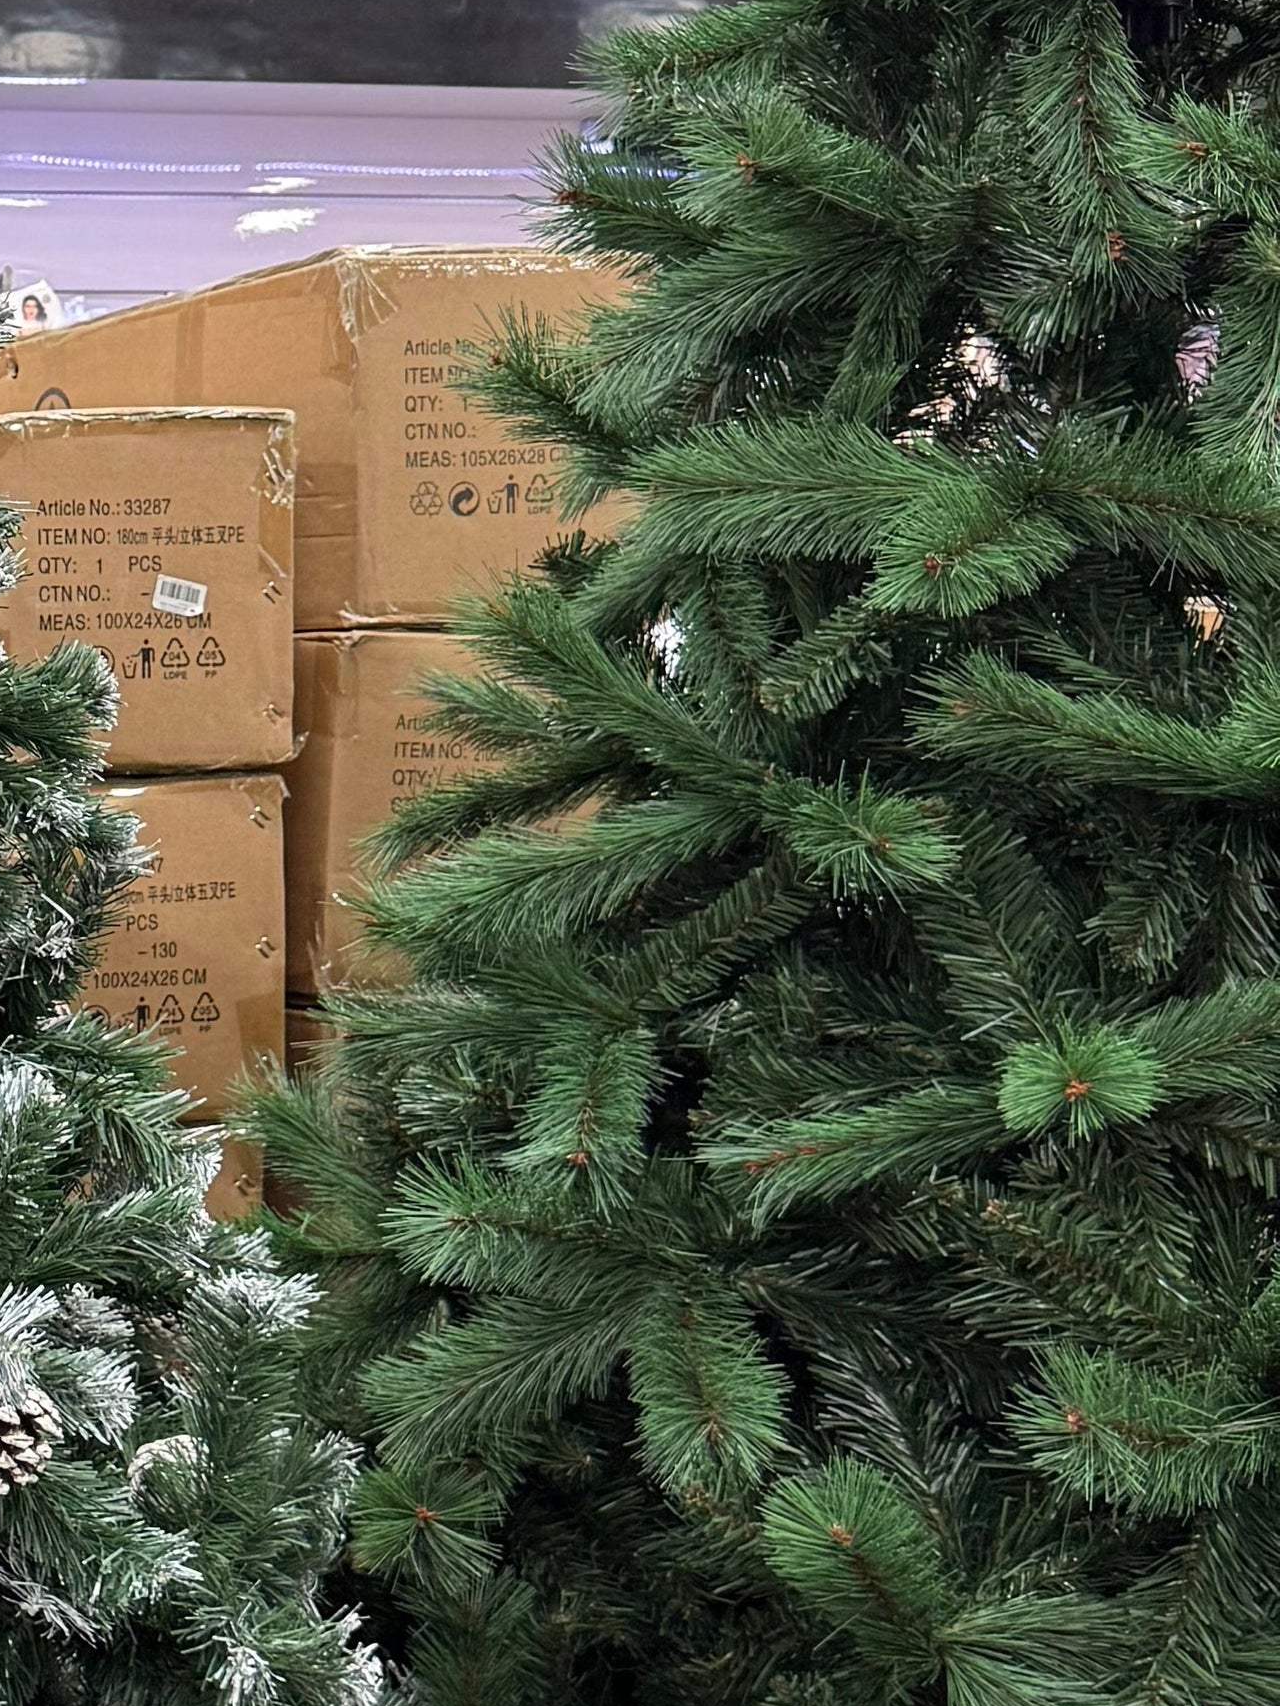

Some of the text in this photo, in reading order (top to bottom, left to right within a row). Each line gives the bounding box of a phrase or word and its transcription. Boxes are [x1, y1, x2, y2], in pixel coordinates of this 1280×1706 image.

[404, 339, 451, 356] Article
[404, 367, 443, 384] ITEM
[404, 395, 443, 413] QTY:
[404, 422, 476, 440] CTN NO.:
[405, 451, 457, 468] MEAS:
[461, 448, 545, 467] 105X26X28
[37, 498, 171, 516] Article No.: 33287
[38, 528, 77, 545] ITEM
[82, 527, 111, 544] NO:
[116, 528, 148, 545] 180cm
[38, 555, 162, 574] QTY: 1 PCS
[39, 584, 110, 602] CTN NO.:
[39, 612, 212, 631] MEAS: 100X24X26 CM
[163, 669, 218, 680] LDPE PP
[394, 741, 435, 759] ITEM
[439, 743, 468, 760] NO:
[126, 914, 159, 932] PCS
[93, 968, 207, 989] 100X24X26 CM
